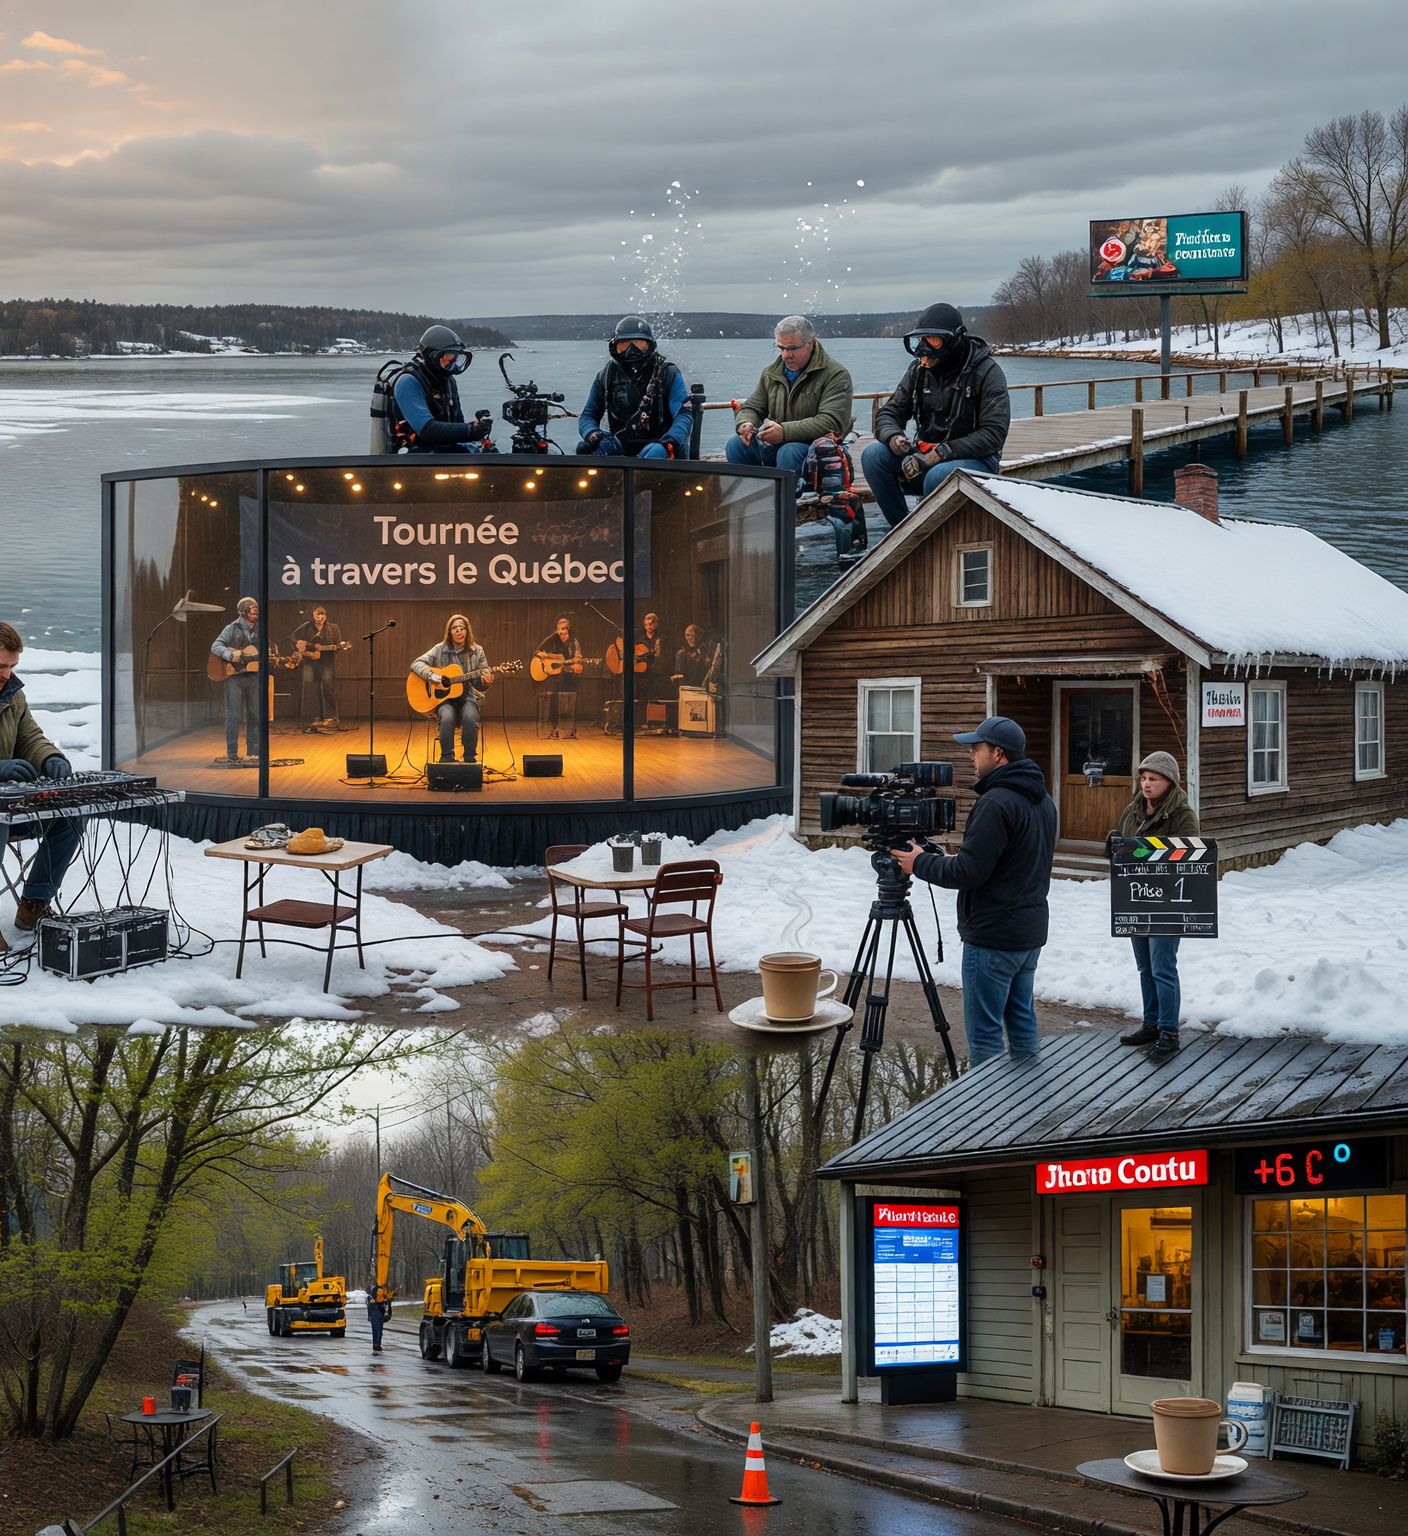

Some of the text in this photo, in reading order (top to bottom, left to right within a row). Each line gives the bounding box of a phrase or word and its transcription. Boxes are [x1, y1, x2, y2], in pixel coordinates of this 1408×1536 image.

[373, 515, 519, 545] Tournée
[281, 555, 301, 585] à
[311, 557, 437, 585] travers
[448, 554, 478, 584] le
[1171, 877, 1193, 902] 1
